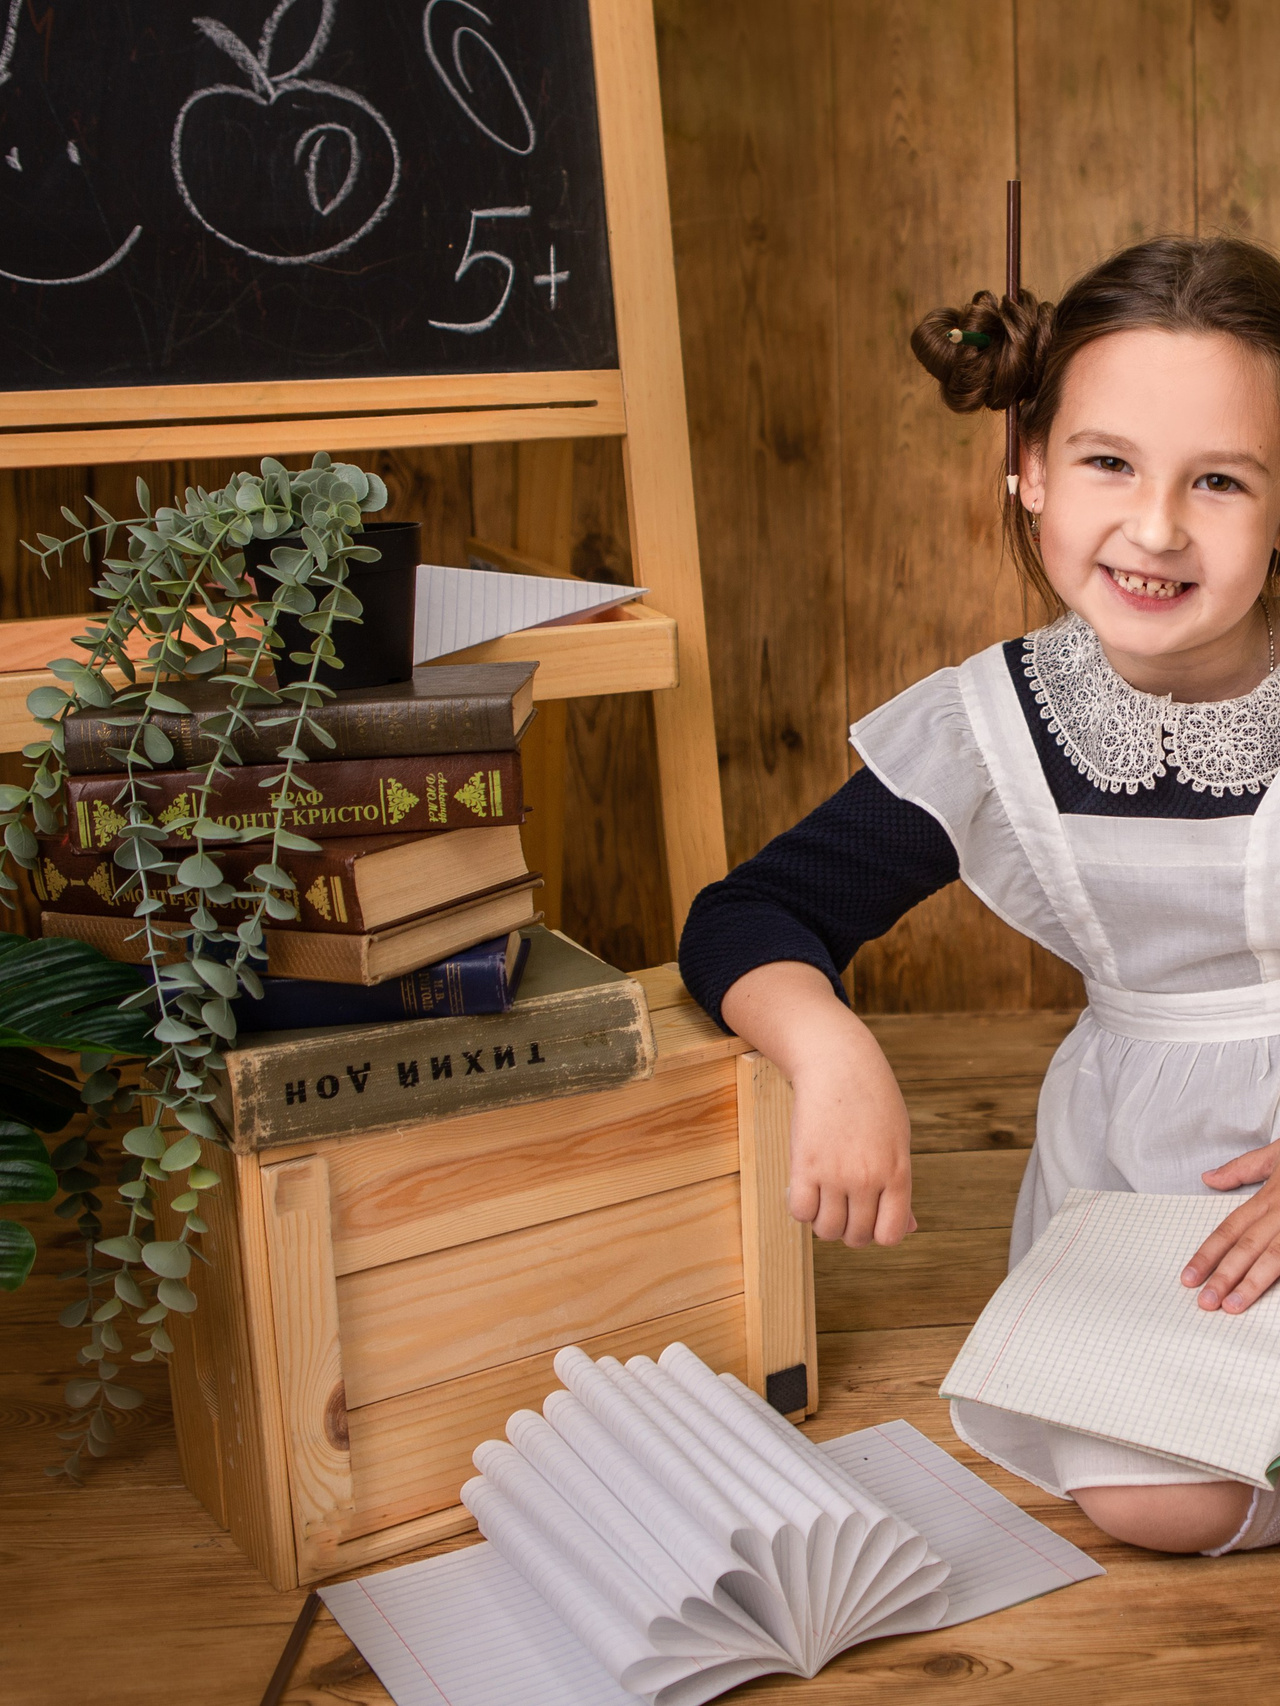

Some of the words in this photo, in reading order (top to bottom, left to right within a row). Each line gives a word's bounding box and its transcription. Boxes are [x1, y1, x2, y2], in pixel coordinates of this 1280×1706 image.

[428, 206, 570, 333] 5+
[438, 772, 448, 823] Александр
[284, 1062, 372, 1106] ДОН
[397, 1041, 546, 1089] ТИХИЙ
